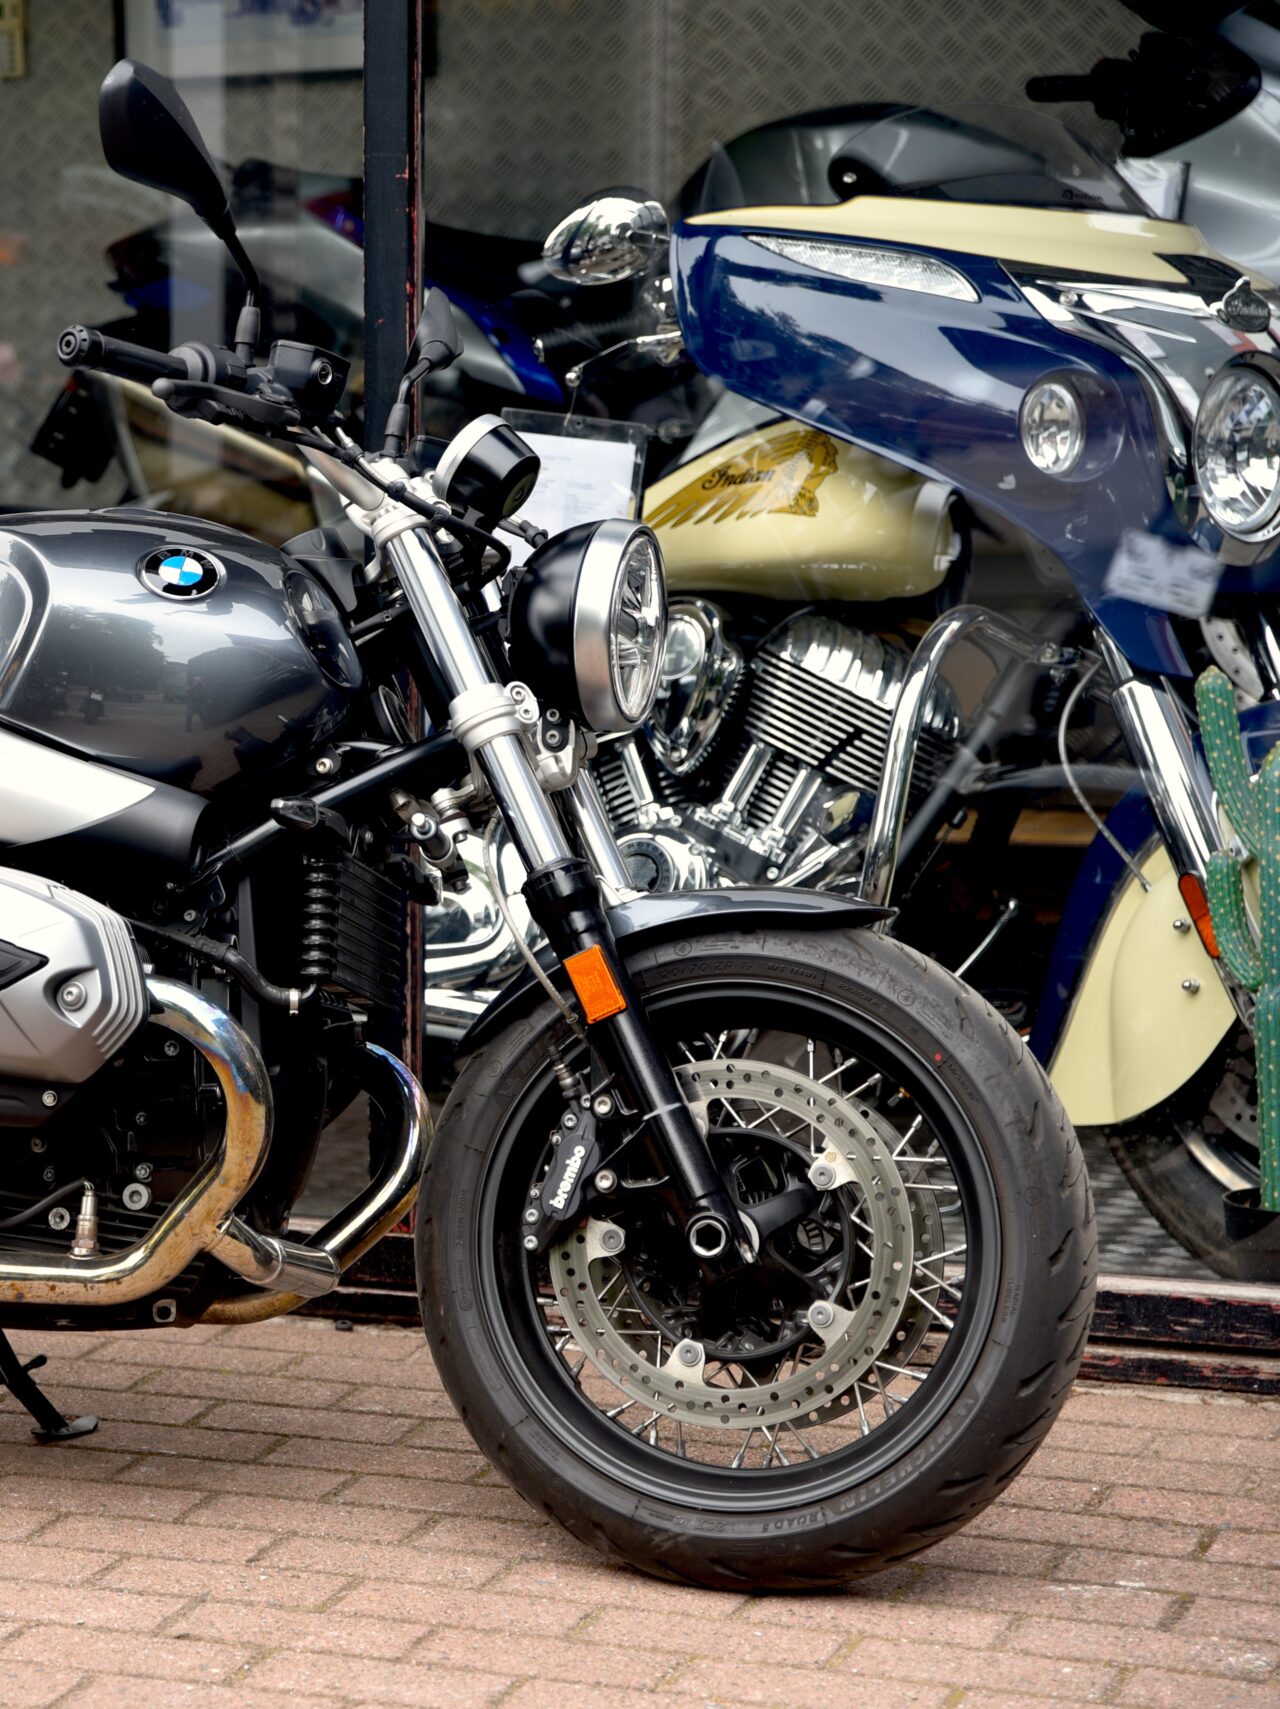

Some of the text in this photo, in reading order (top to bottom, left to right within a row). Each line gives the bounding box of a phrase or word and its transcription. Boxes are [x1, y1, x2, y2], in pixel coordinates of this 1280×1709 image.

[702, 463, 775, 490] Indian
[157, 549, 214, 570] BMW
[549, 1145, 586, 1210] brembo
[839, 1420, 954, 1512] MICHELIN
[695, 1519, 730, 1533] 2CT
[774, 1509, 820, 1530] ROAD
